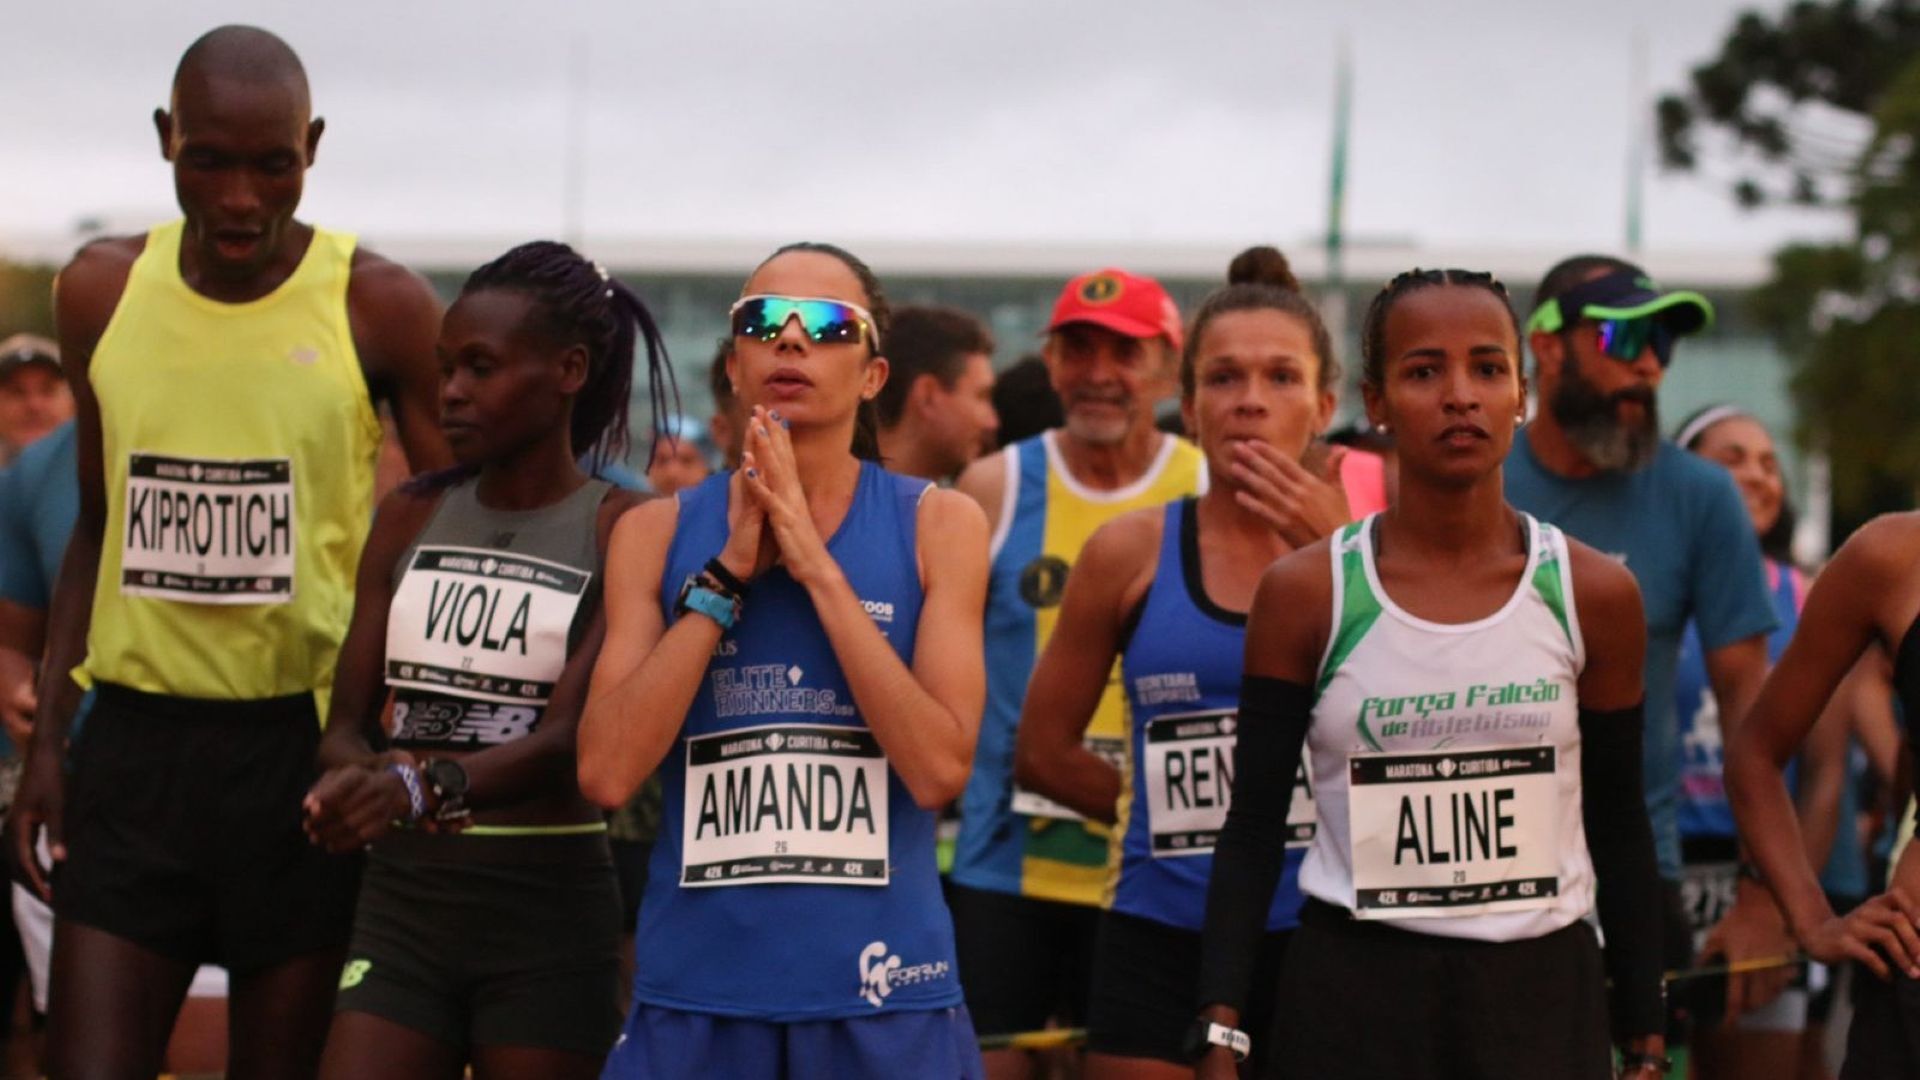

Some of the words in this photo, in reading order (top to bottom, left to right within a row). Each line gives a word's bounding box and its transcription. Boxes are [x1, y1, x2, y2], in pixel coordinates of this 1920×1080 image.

[128, 487, 291, 557] KIPROTICH
[424, 578, 532, 656] VIOLA
[859, 600, 894, 615] OOB
[712, 664, 787, 691] ELITE
[714, 690, 836, 718] RUNNERS
[1381, 720, 1409, 738] de
[721, 737, 763, 757] MARATONA
[787, 735, 829, 751] CURITIBA
[1165, 746, 1313, 811] RENA
[1385, 763, 1435, 779] MARATONA
[1459, 758, 1501, 776] CURITIBA
[696, 763, 876, 841] AMANDA
[1394, 788, 1518, 866] ALINE
